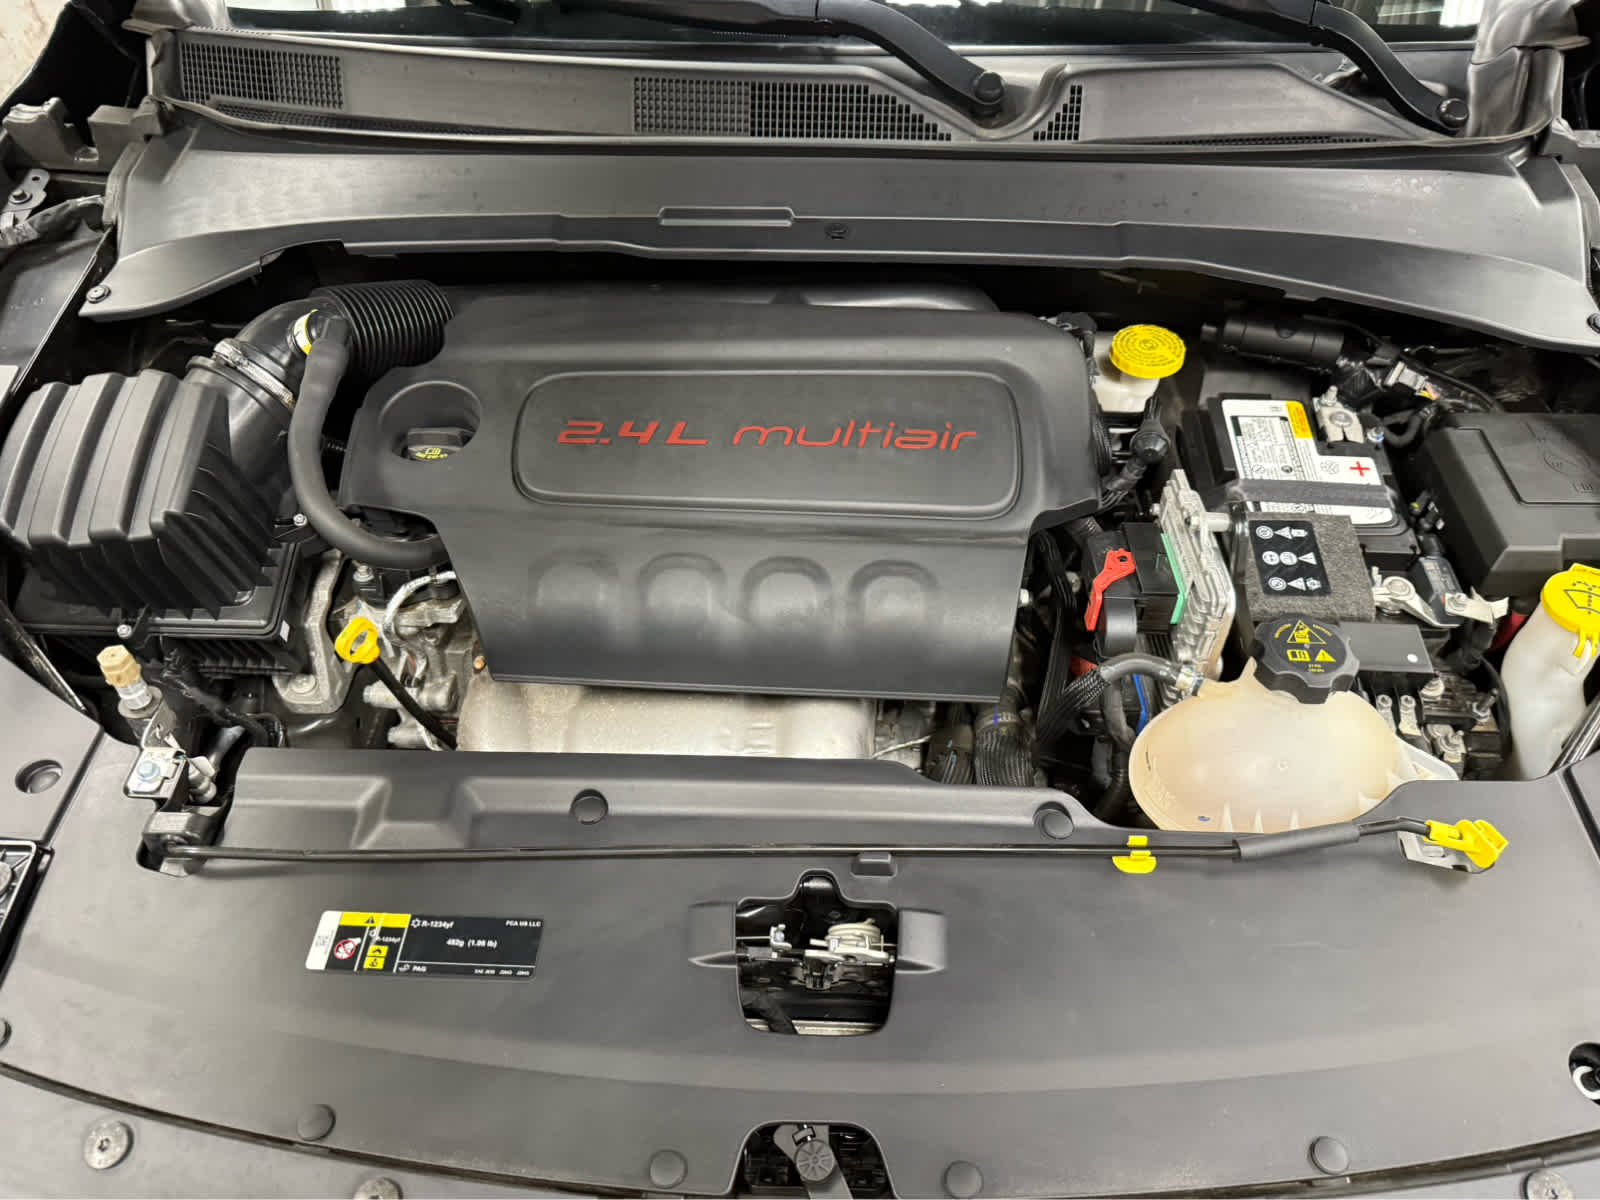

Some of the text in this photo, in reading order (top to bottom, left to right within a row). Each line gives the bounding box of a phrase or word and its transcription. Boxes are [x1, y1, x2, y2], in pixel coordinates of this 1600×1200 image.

[557, 419, 977, 451] 2.4L multiair
[421, 920, 455, 930] R-1234yf
